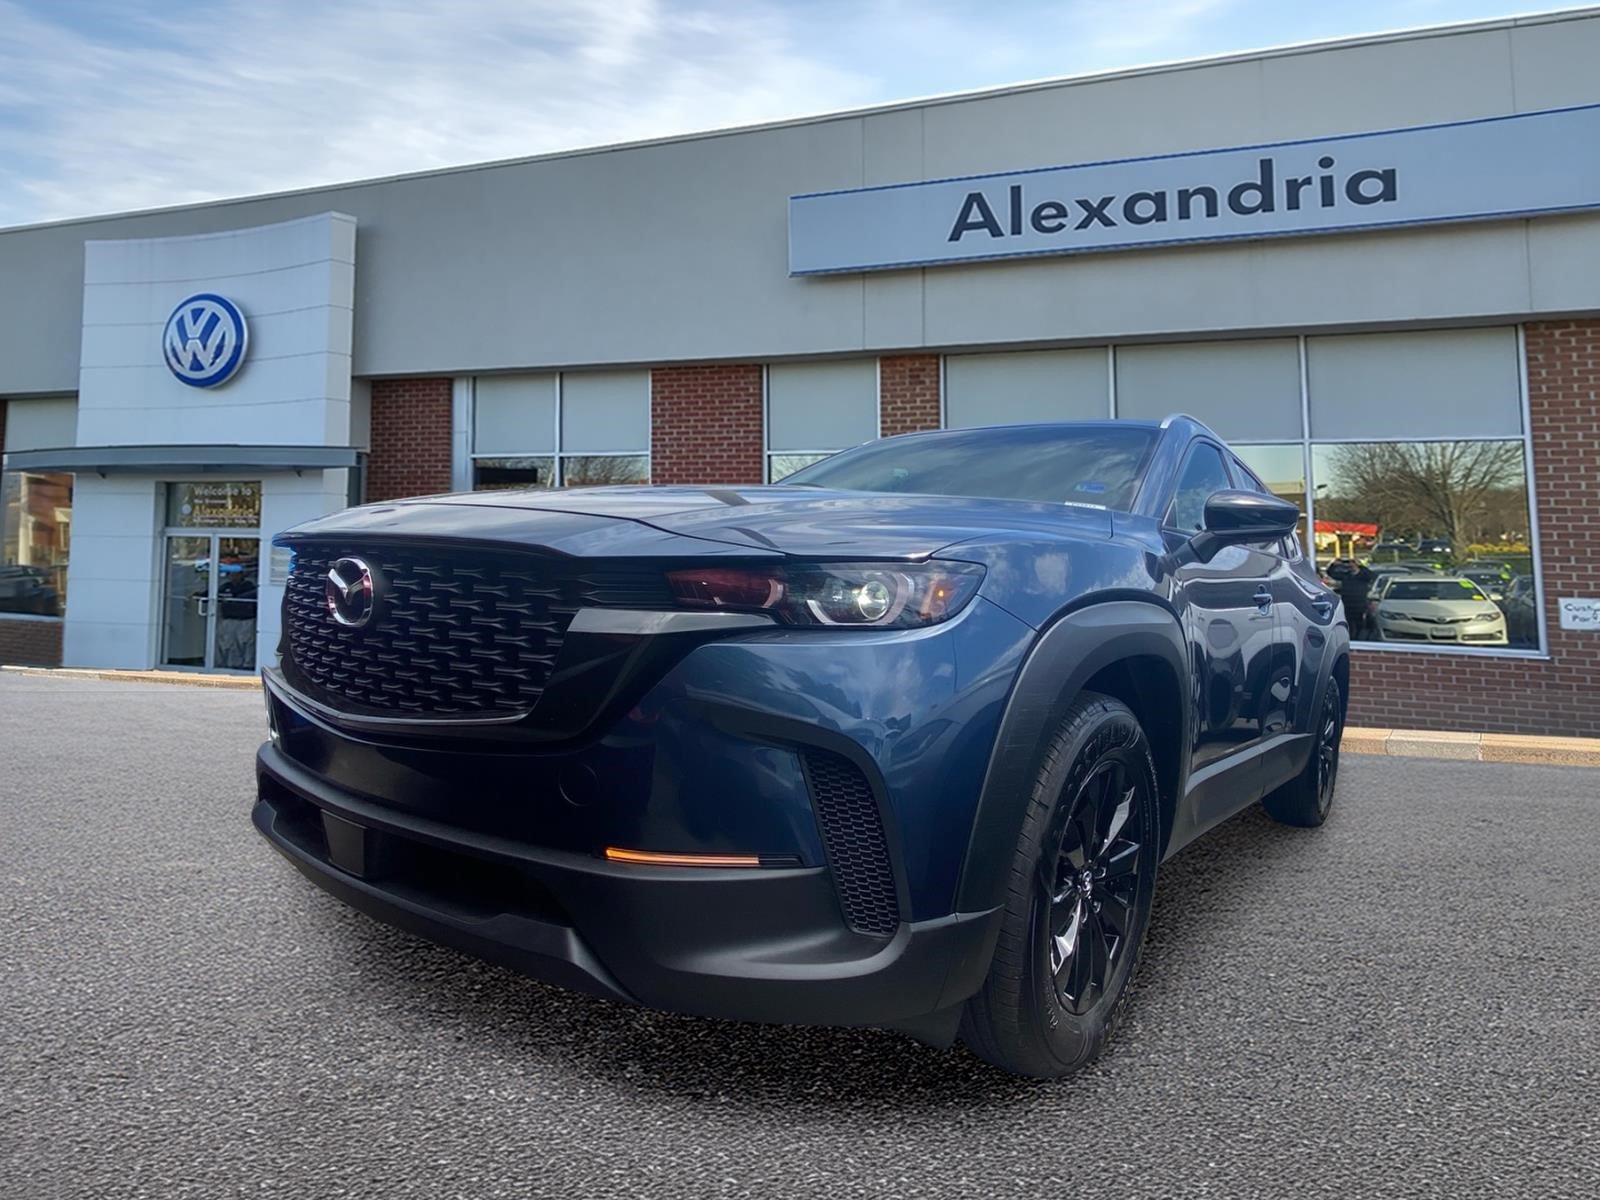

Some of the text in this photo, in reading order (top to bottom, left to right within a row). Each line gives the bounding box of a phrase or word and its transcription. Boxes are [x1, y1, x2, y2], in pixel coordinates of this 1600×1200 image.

[948, 156, 1397, 242] Alexandria
[166, 299, 235, 378] VW
[1564, 602, 1600, 613] Cust
